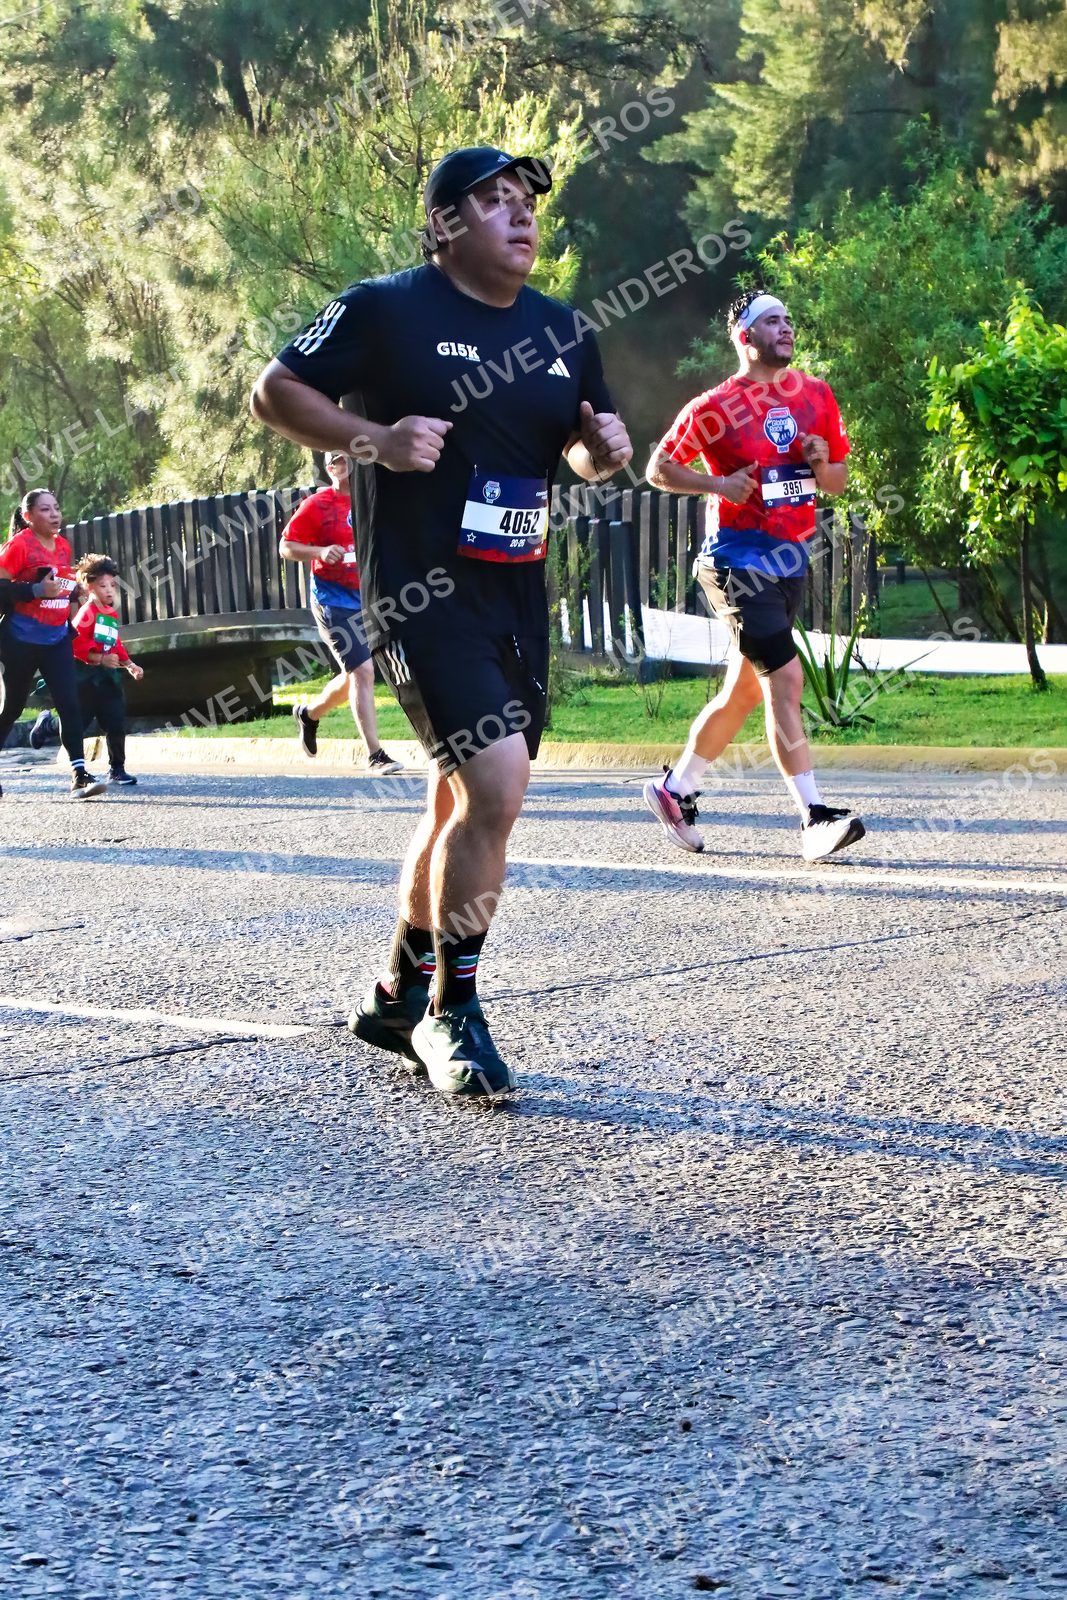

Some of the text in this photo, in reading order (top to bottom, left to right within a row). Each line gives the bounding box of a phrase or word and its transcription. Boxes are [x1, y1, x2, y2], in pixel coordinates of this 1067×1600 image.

[437, 342, 480, 360] G15K
[782, 481, 803, 496] 3951
[499, 510, 540, 535] 4052
